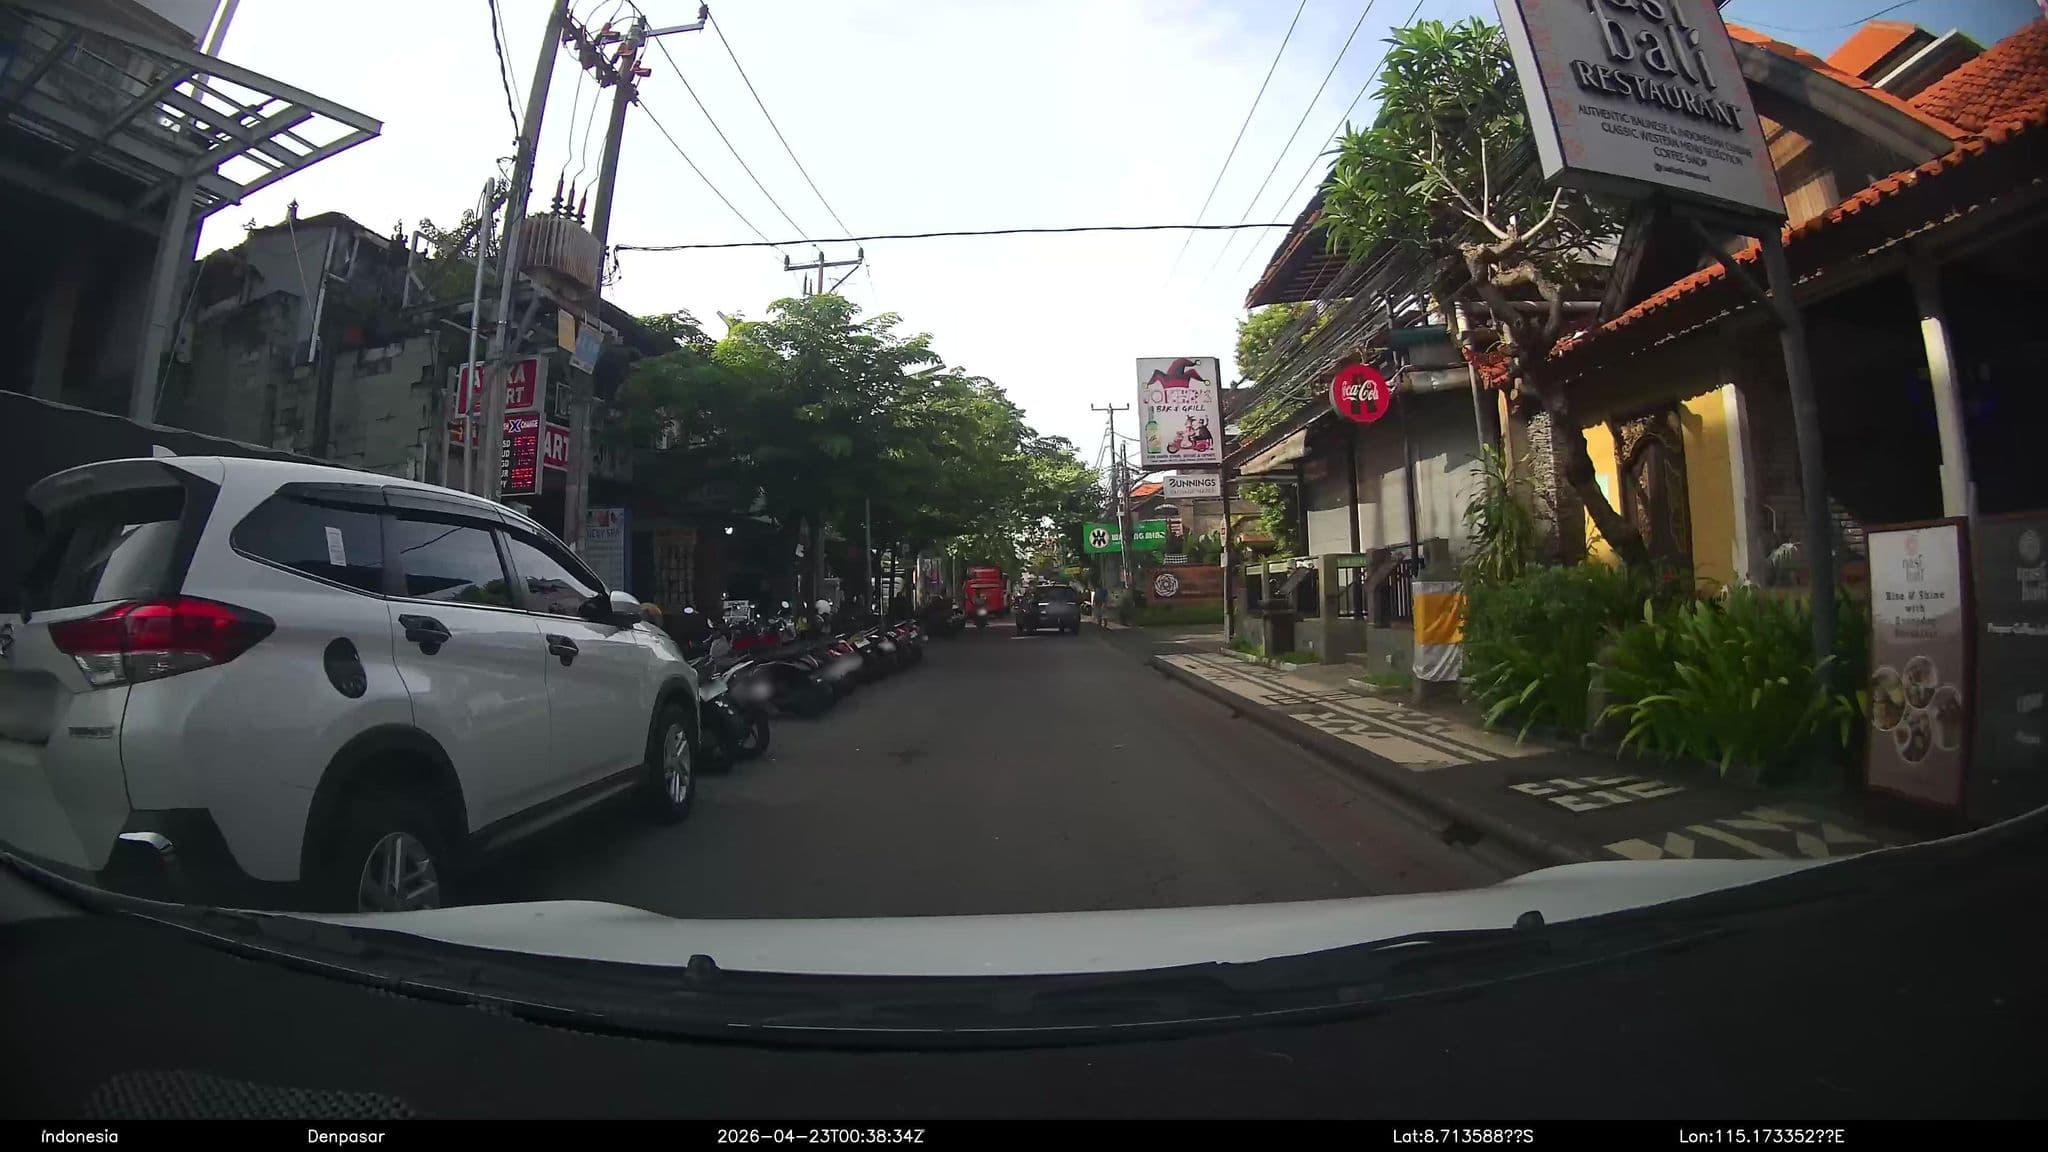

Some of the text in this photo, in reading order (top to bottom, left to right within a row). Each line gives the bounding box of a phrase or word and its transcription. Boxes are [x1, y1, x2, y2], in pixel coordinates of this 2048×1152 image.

[1570, 60, 1743, 131] RESTAURANT
[1579, 104, 1630, 123] AUTHENTIC
[1601, 122, 1639, 139] CLASSIC
[1654, 146, 1686, 162] COFFEE
[1156, 405, 1172, 413] BAR
[1182, 404, 1206, 412] GRILL
[502, 439, 511, 448] SD
[1918, 589, 1945, 600] Shine
[1904, 603, 1925, 614] with
